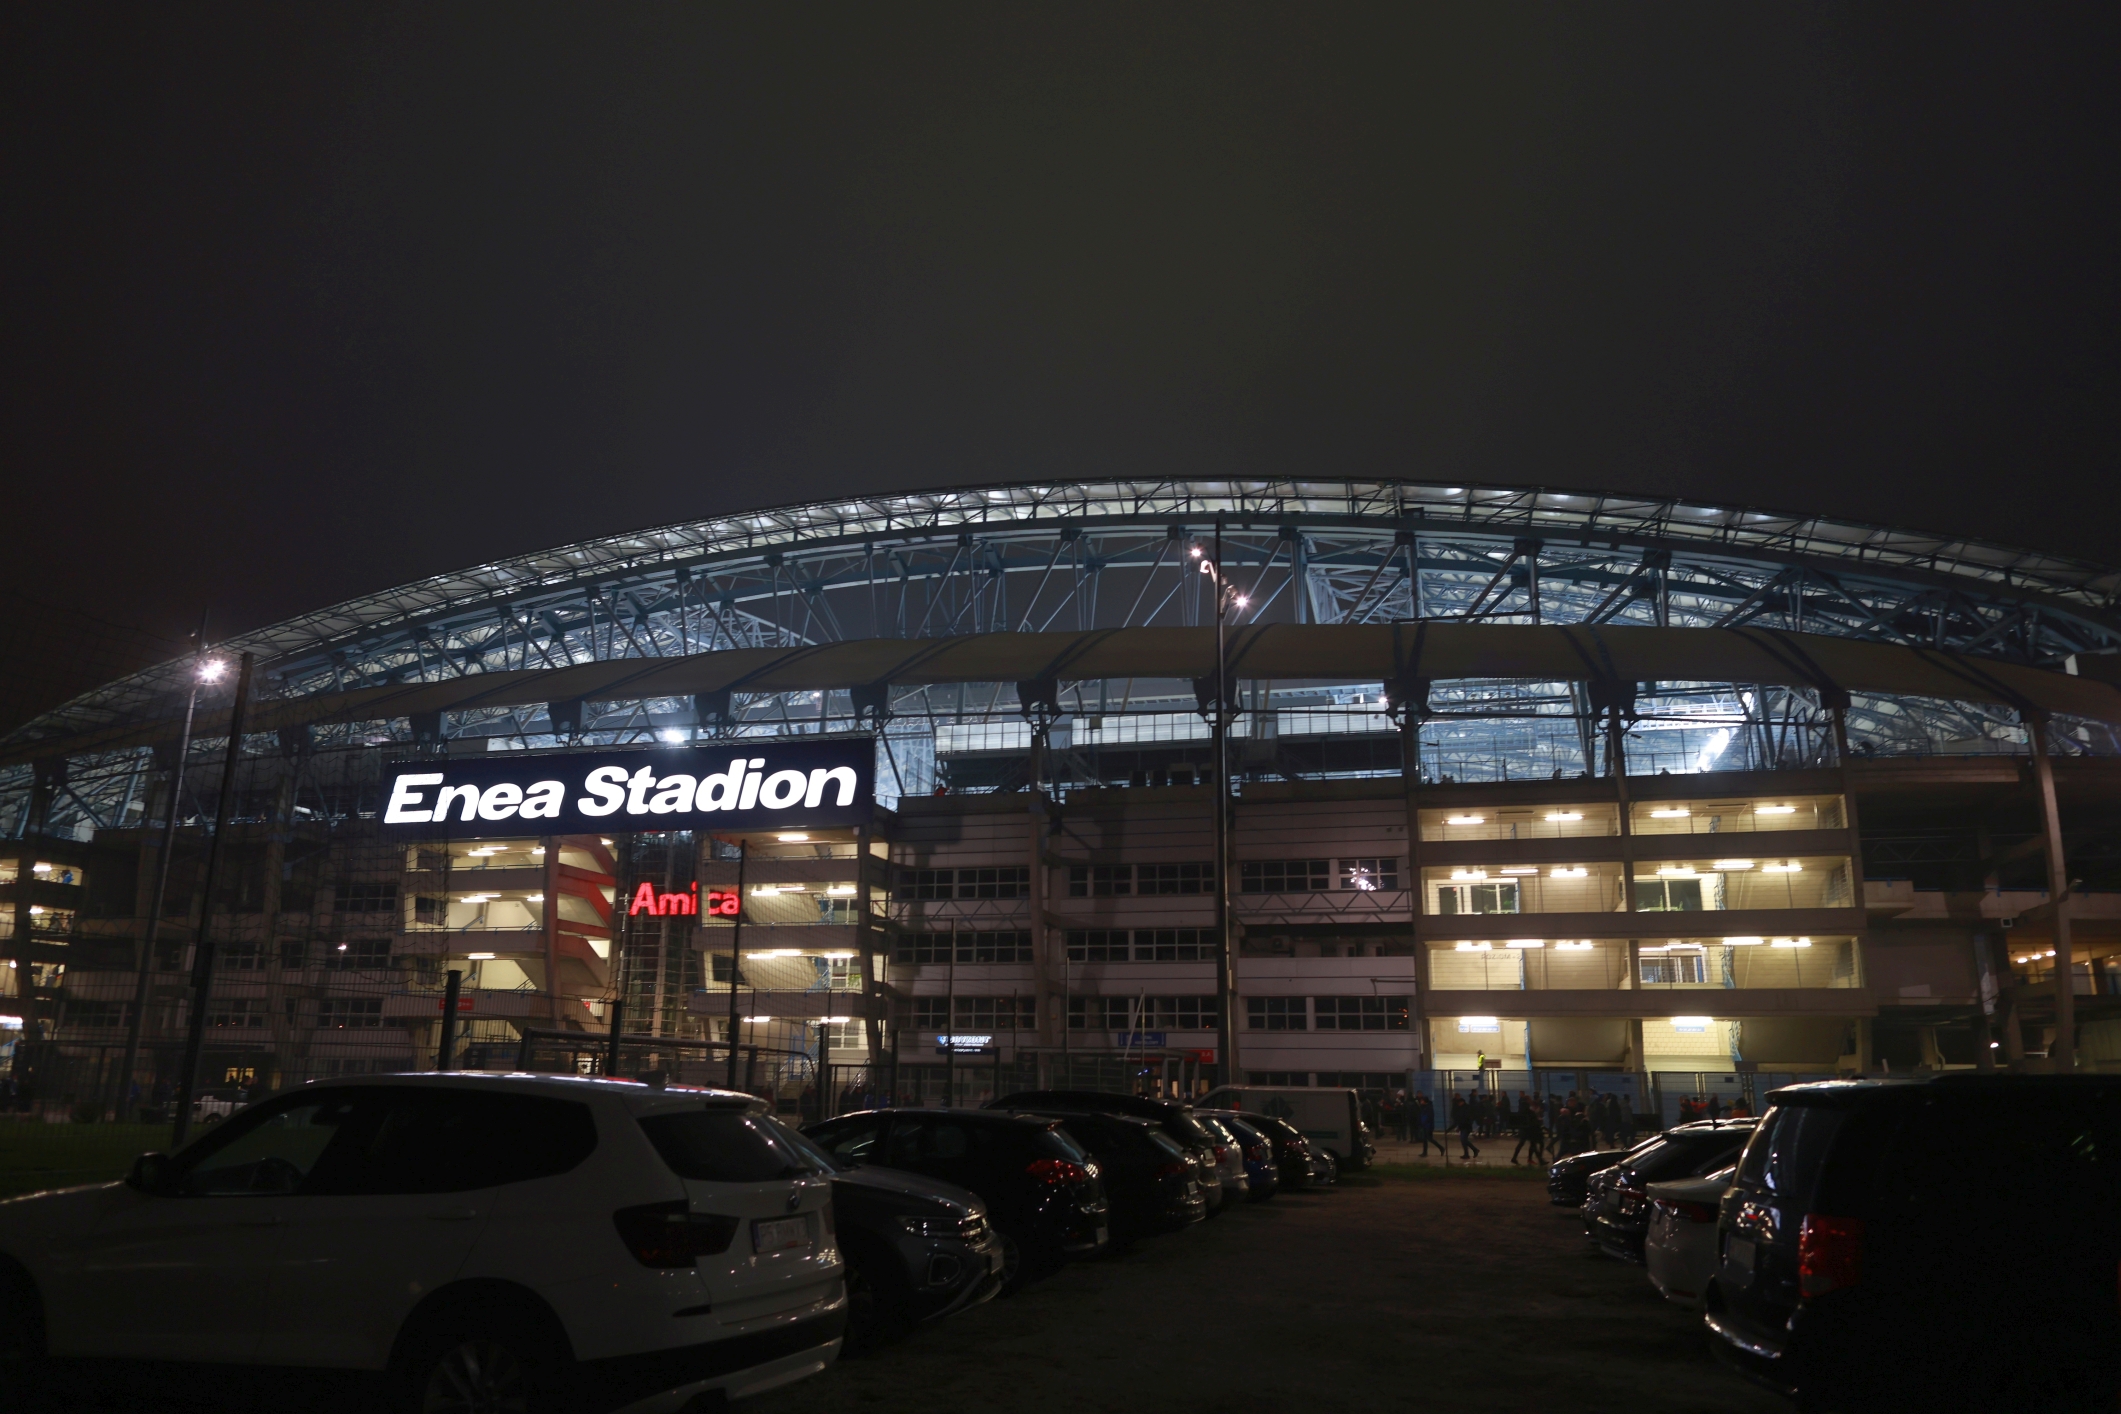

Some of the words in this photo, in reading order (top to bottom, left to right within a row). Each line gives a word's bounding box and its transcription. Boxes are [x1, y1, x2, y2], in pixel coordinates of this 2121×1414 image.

[384, 772, 565, 824] Enea
[578, 758, 857, 816] Stadion
[629, 880, 741, 916] Amica
